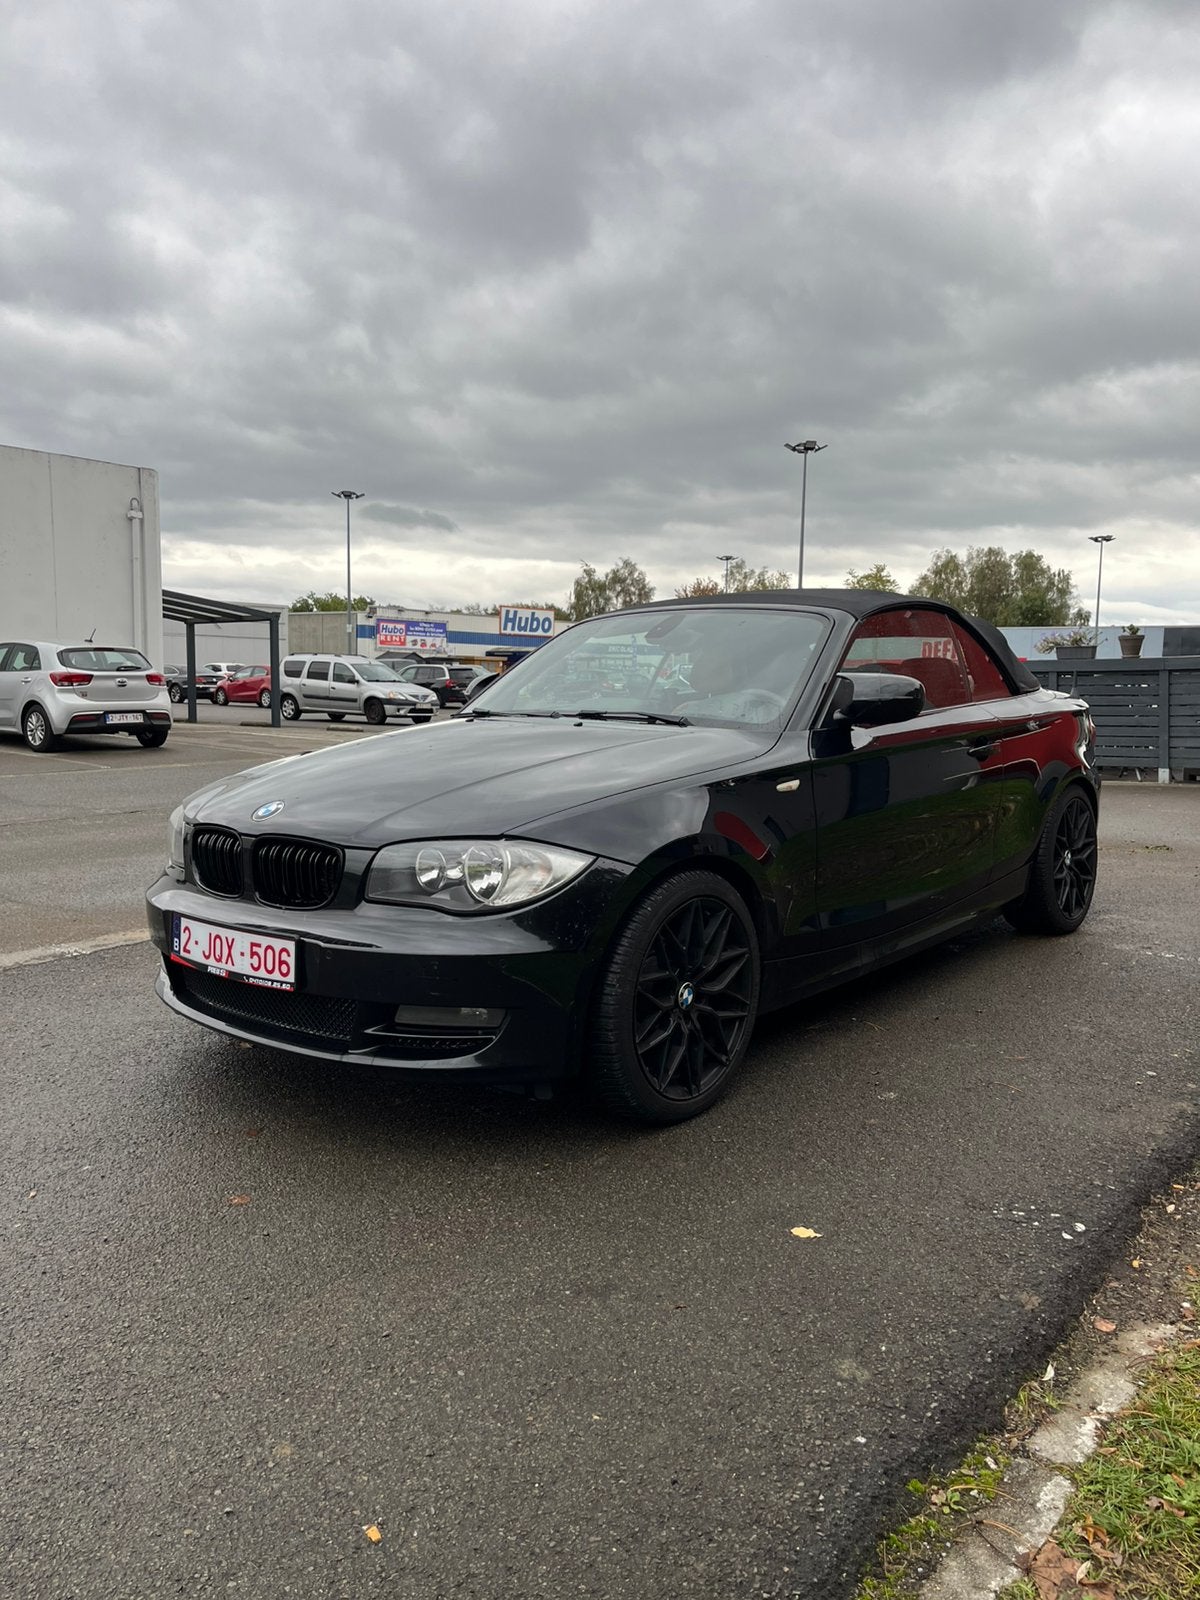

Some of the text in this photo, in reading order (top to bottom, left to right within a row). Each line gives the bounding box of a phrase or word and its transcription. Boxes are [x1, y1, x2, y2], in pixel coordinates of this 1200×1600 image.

[381, 624, 404, 635] Hubo
[502, 609, 553, 633] Hubo
[173, 926, 291, 977] B 2-JQX-506
